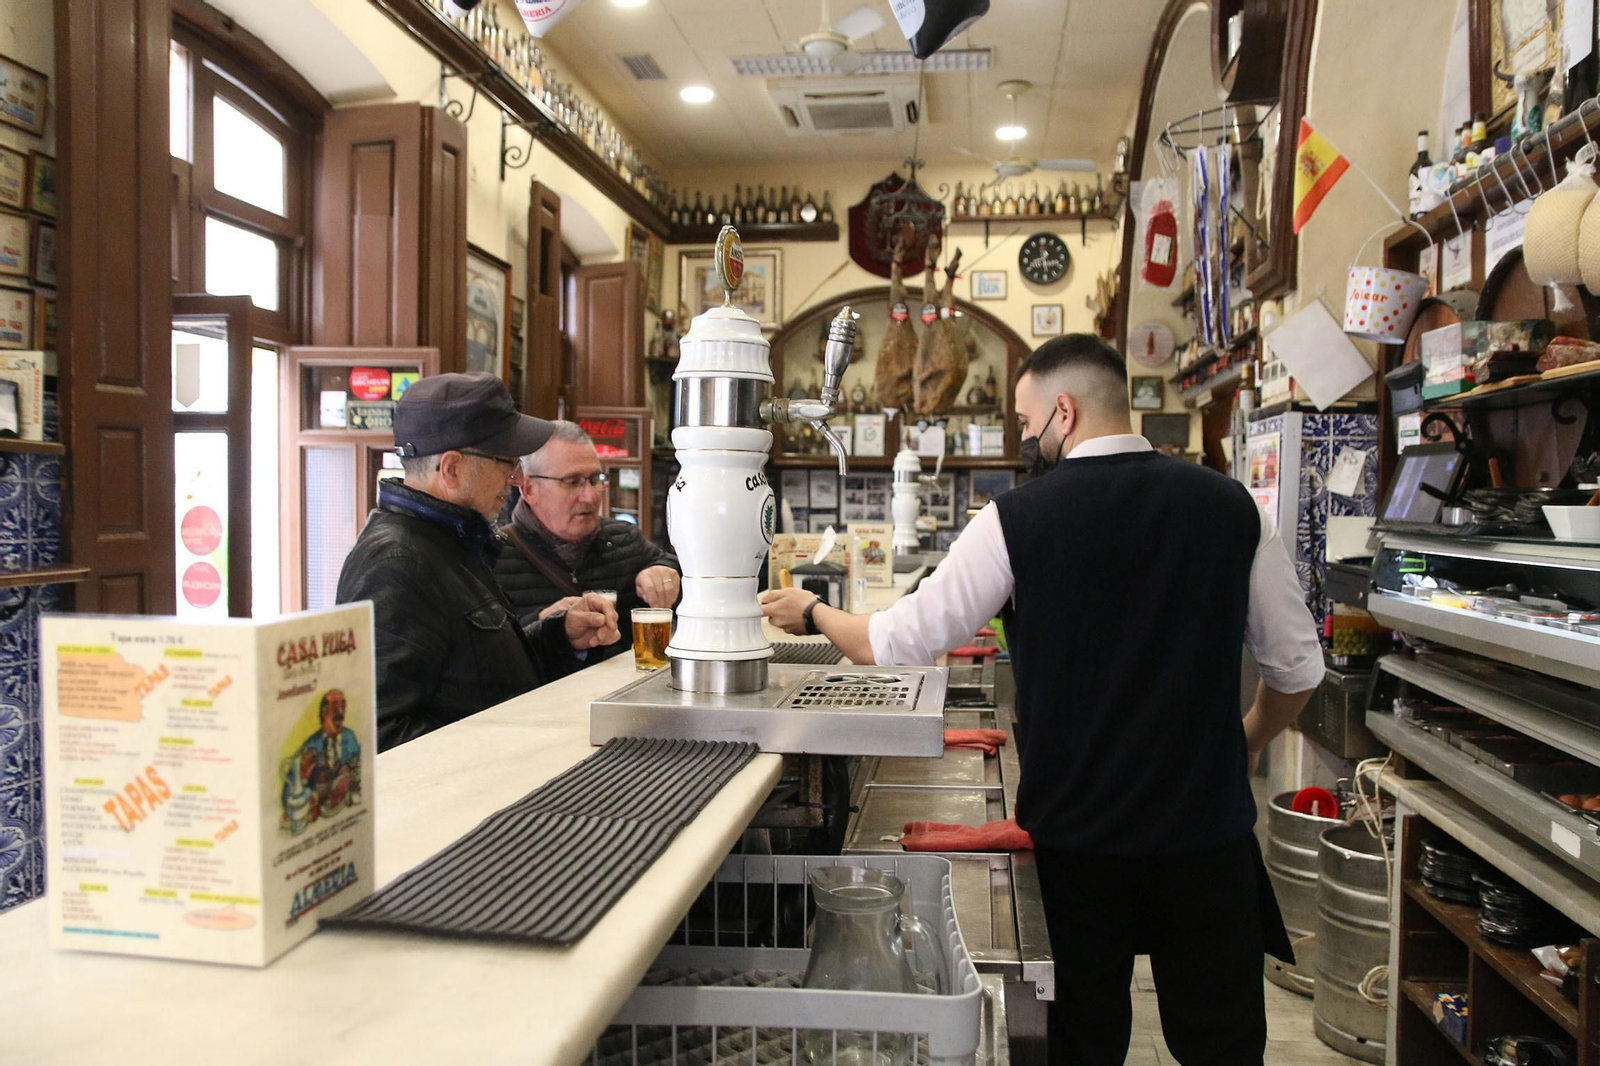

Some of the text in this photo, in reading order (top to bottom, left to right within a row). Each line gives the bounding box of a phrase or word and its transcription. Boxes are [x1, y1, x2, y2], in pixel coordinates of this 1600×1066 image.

[351, 378, 390, 387] MICHELIN
[277, 635, 319, 668] CASA
[102, 765, 171, 834] TAPAS
